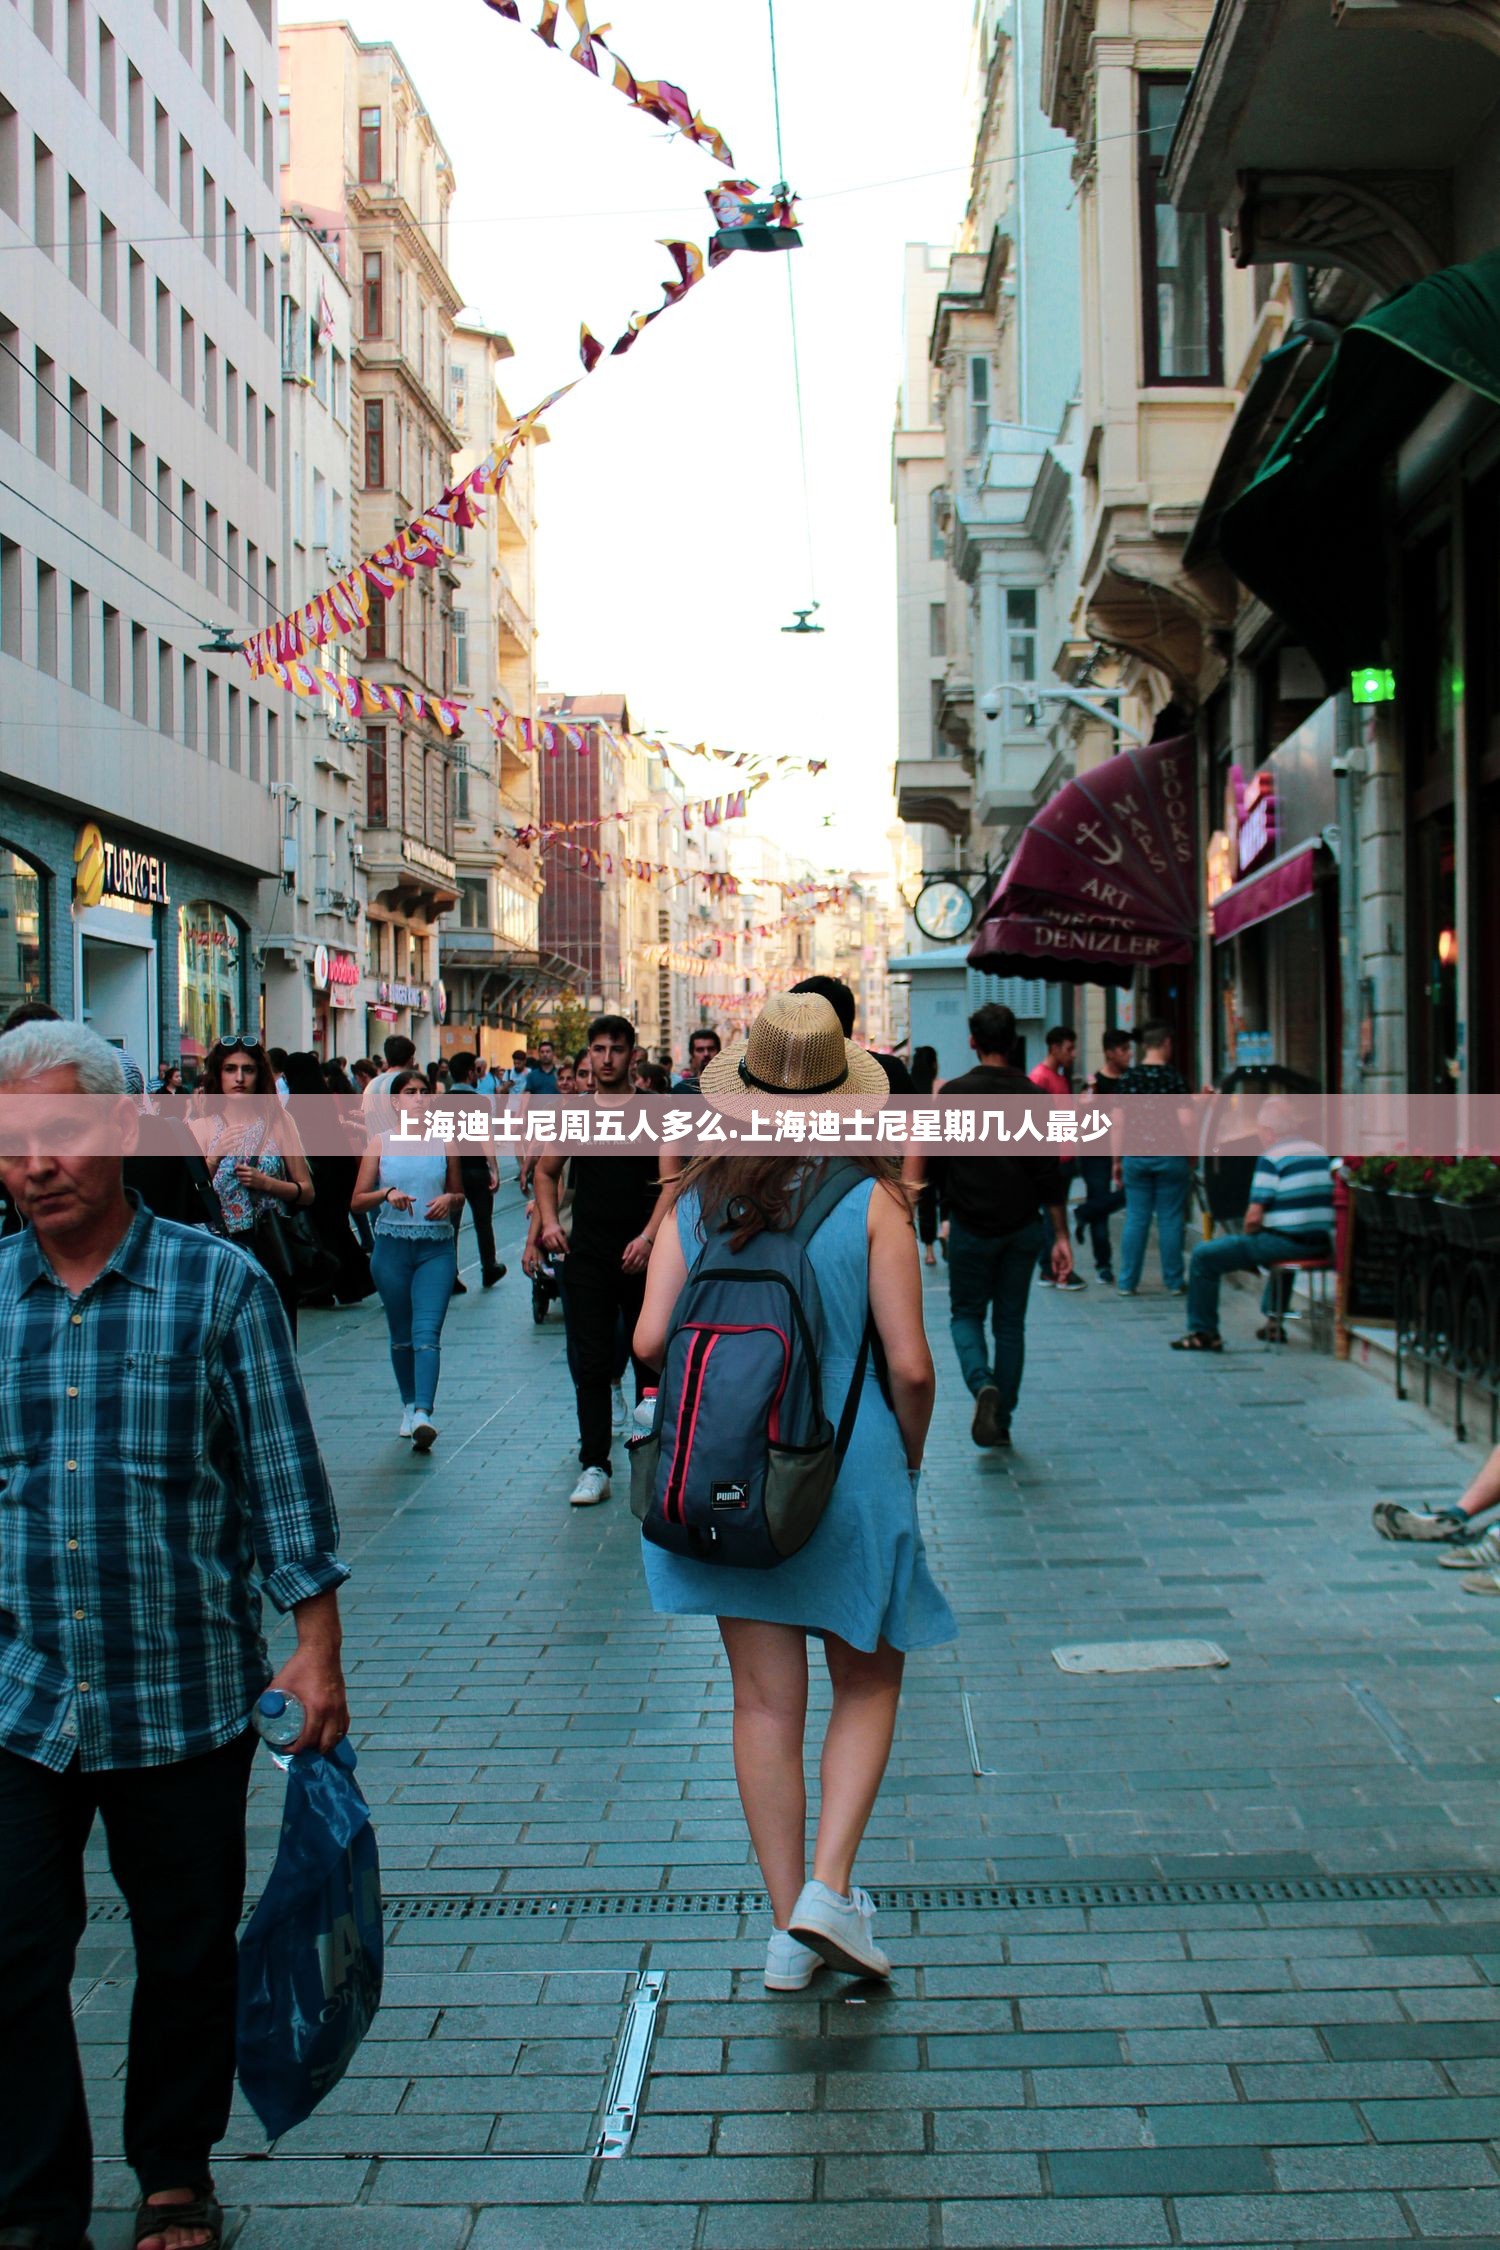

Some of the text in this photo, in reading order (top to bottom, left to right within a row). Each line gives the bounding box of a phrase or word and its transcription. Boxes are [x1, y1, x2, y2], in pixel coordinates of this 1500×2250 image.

[1113, 794, 1167, 873] MAPS
[1160, 759, 1192, 863] BOOKS
[104, 842, 170, 905] TURKCELL
[1080, 877, 1134, 910] ART
[1034, 926, 1161, 956] DENIZLER
[716, 1491, 740, 1502] PUMA
